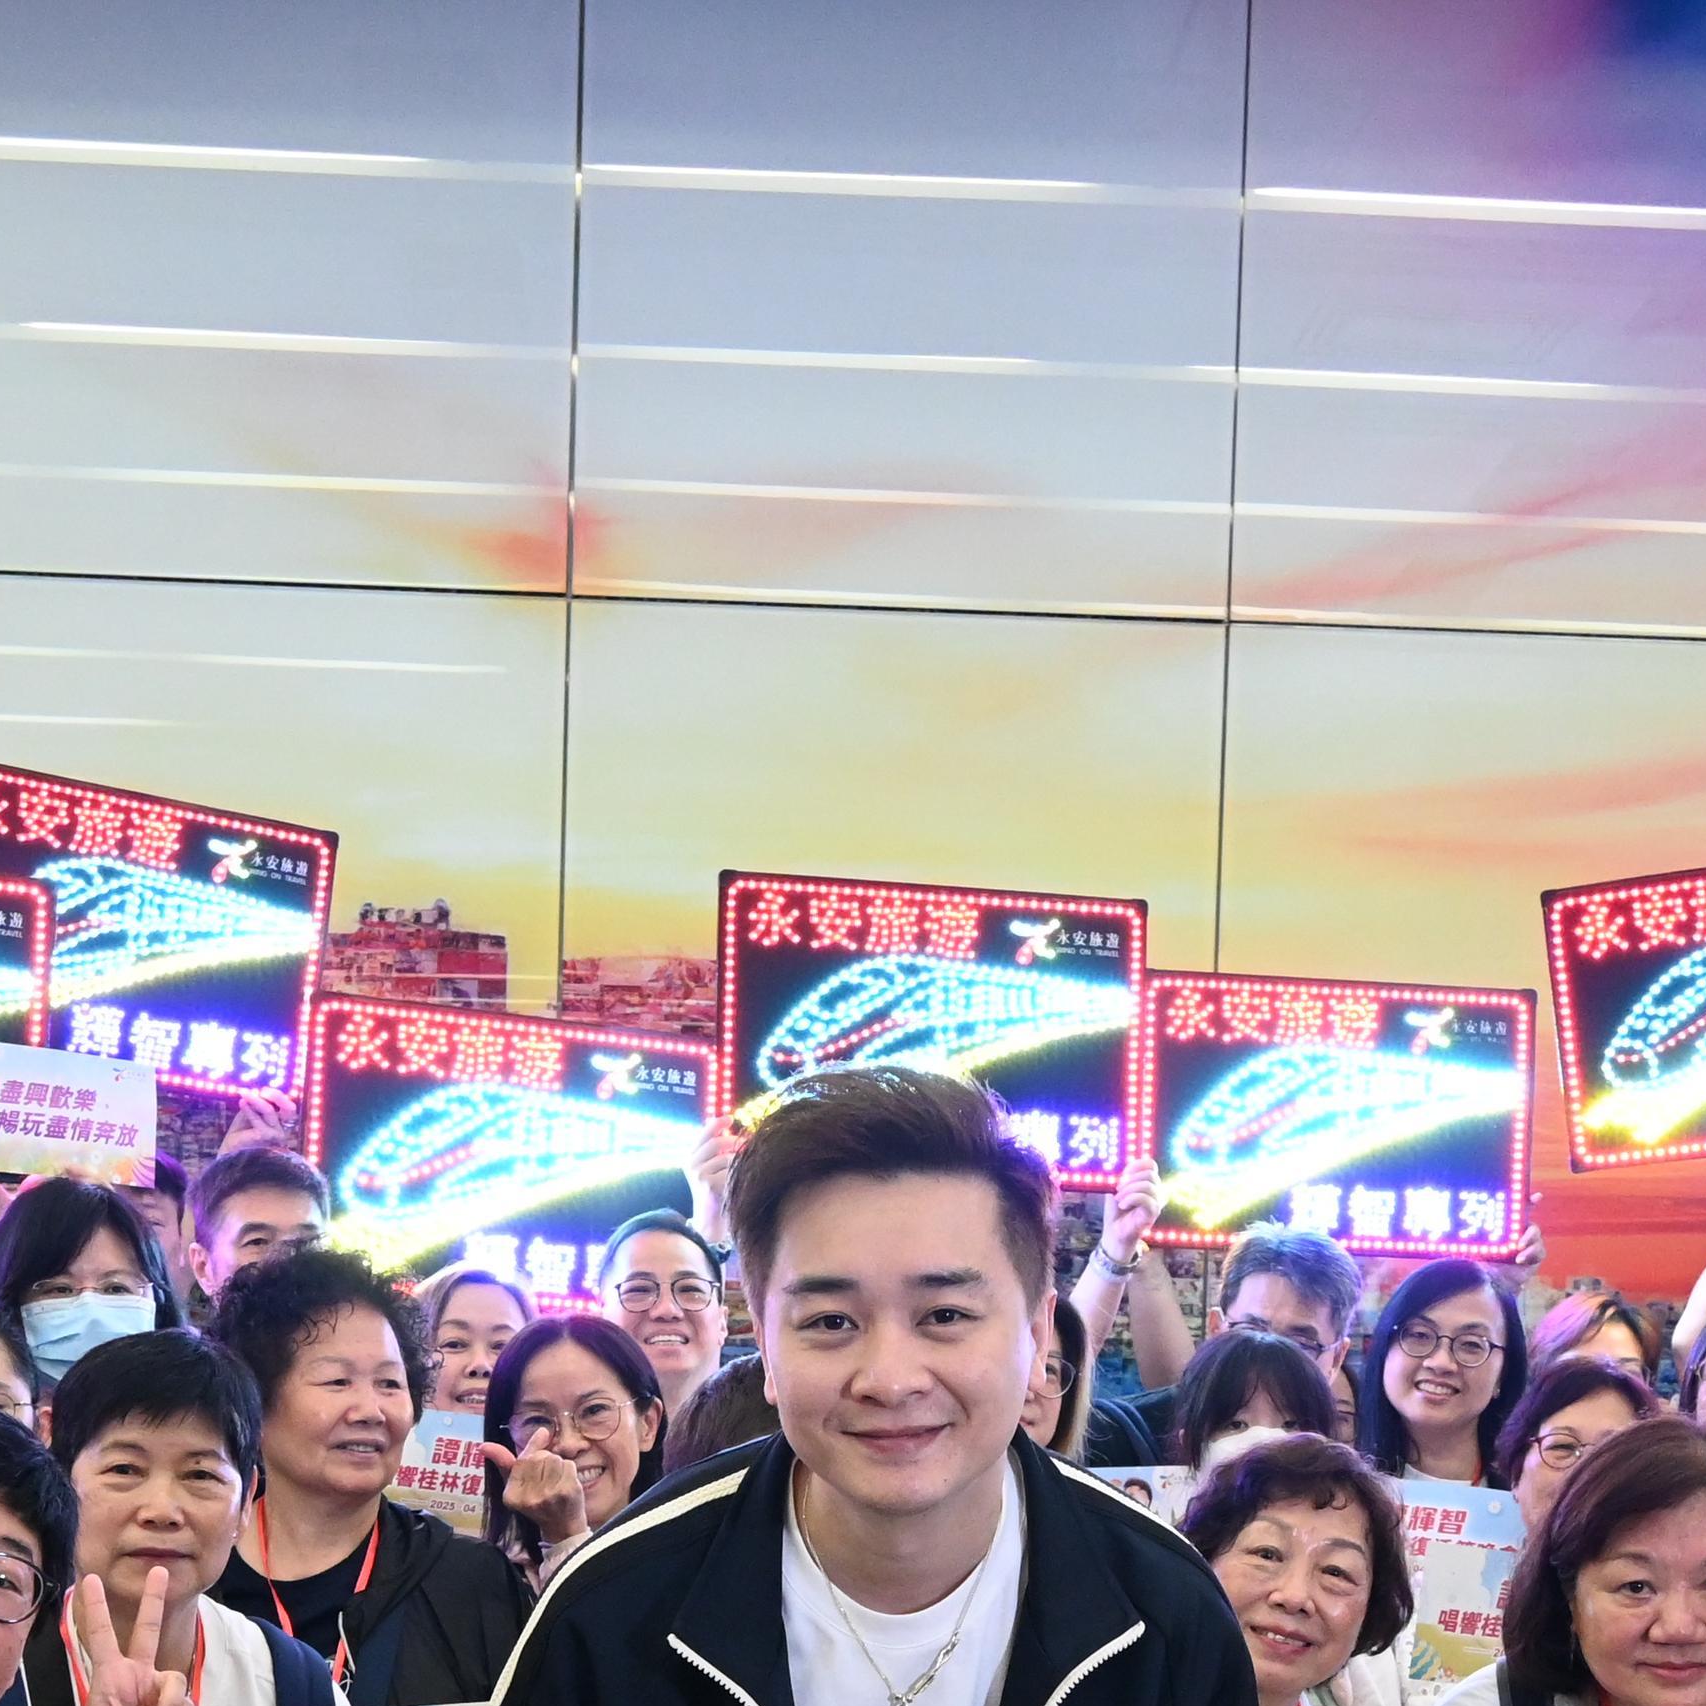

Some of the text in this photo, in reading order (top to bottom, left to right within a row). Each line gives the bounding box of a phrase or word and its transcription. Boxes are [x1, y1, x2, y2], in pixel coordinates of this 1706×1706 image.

[251, 851, 309, 878] 永安旅遊
[747, 890, 980, 960] 永安旅遊
[1056, 930, 1121, 950] 永安旅遊
[336, 1012, 565, 1093] 永安旅遊
[634, 1064, 697, 1088] 永安旅遊
[1397, 1504, 1469, 1536] 輝智
